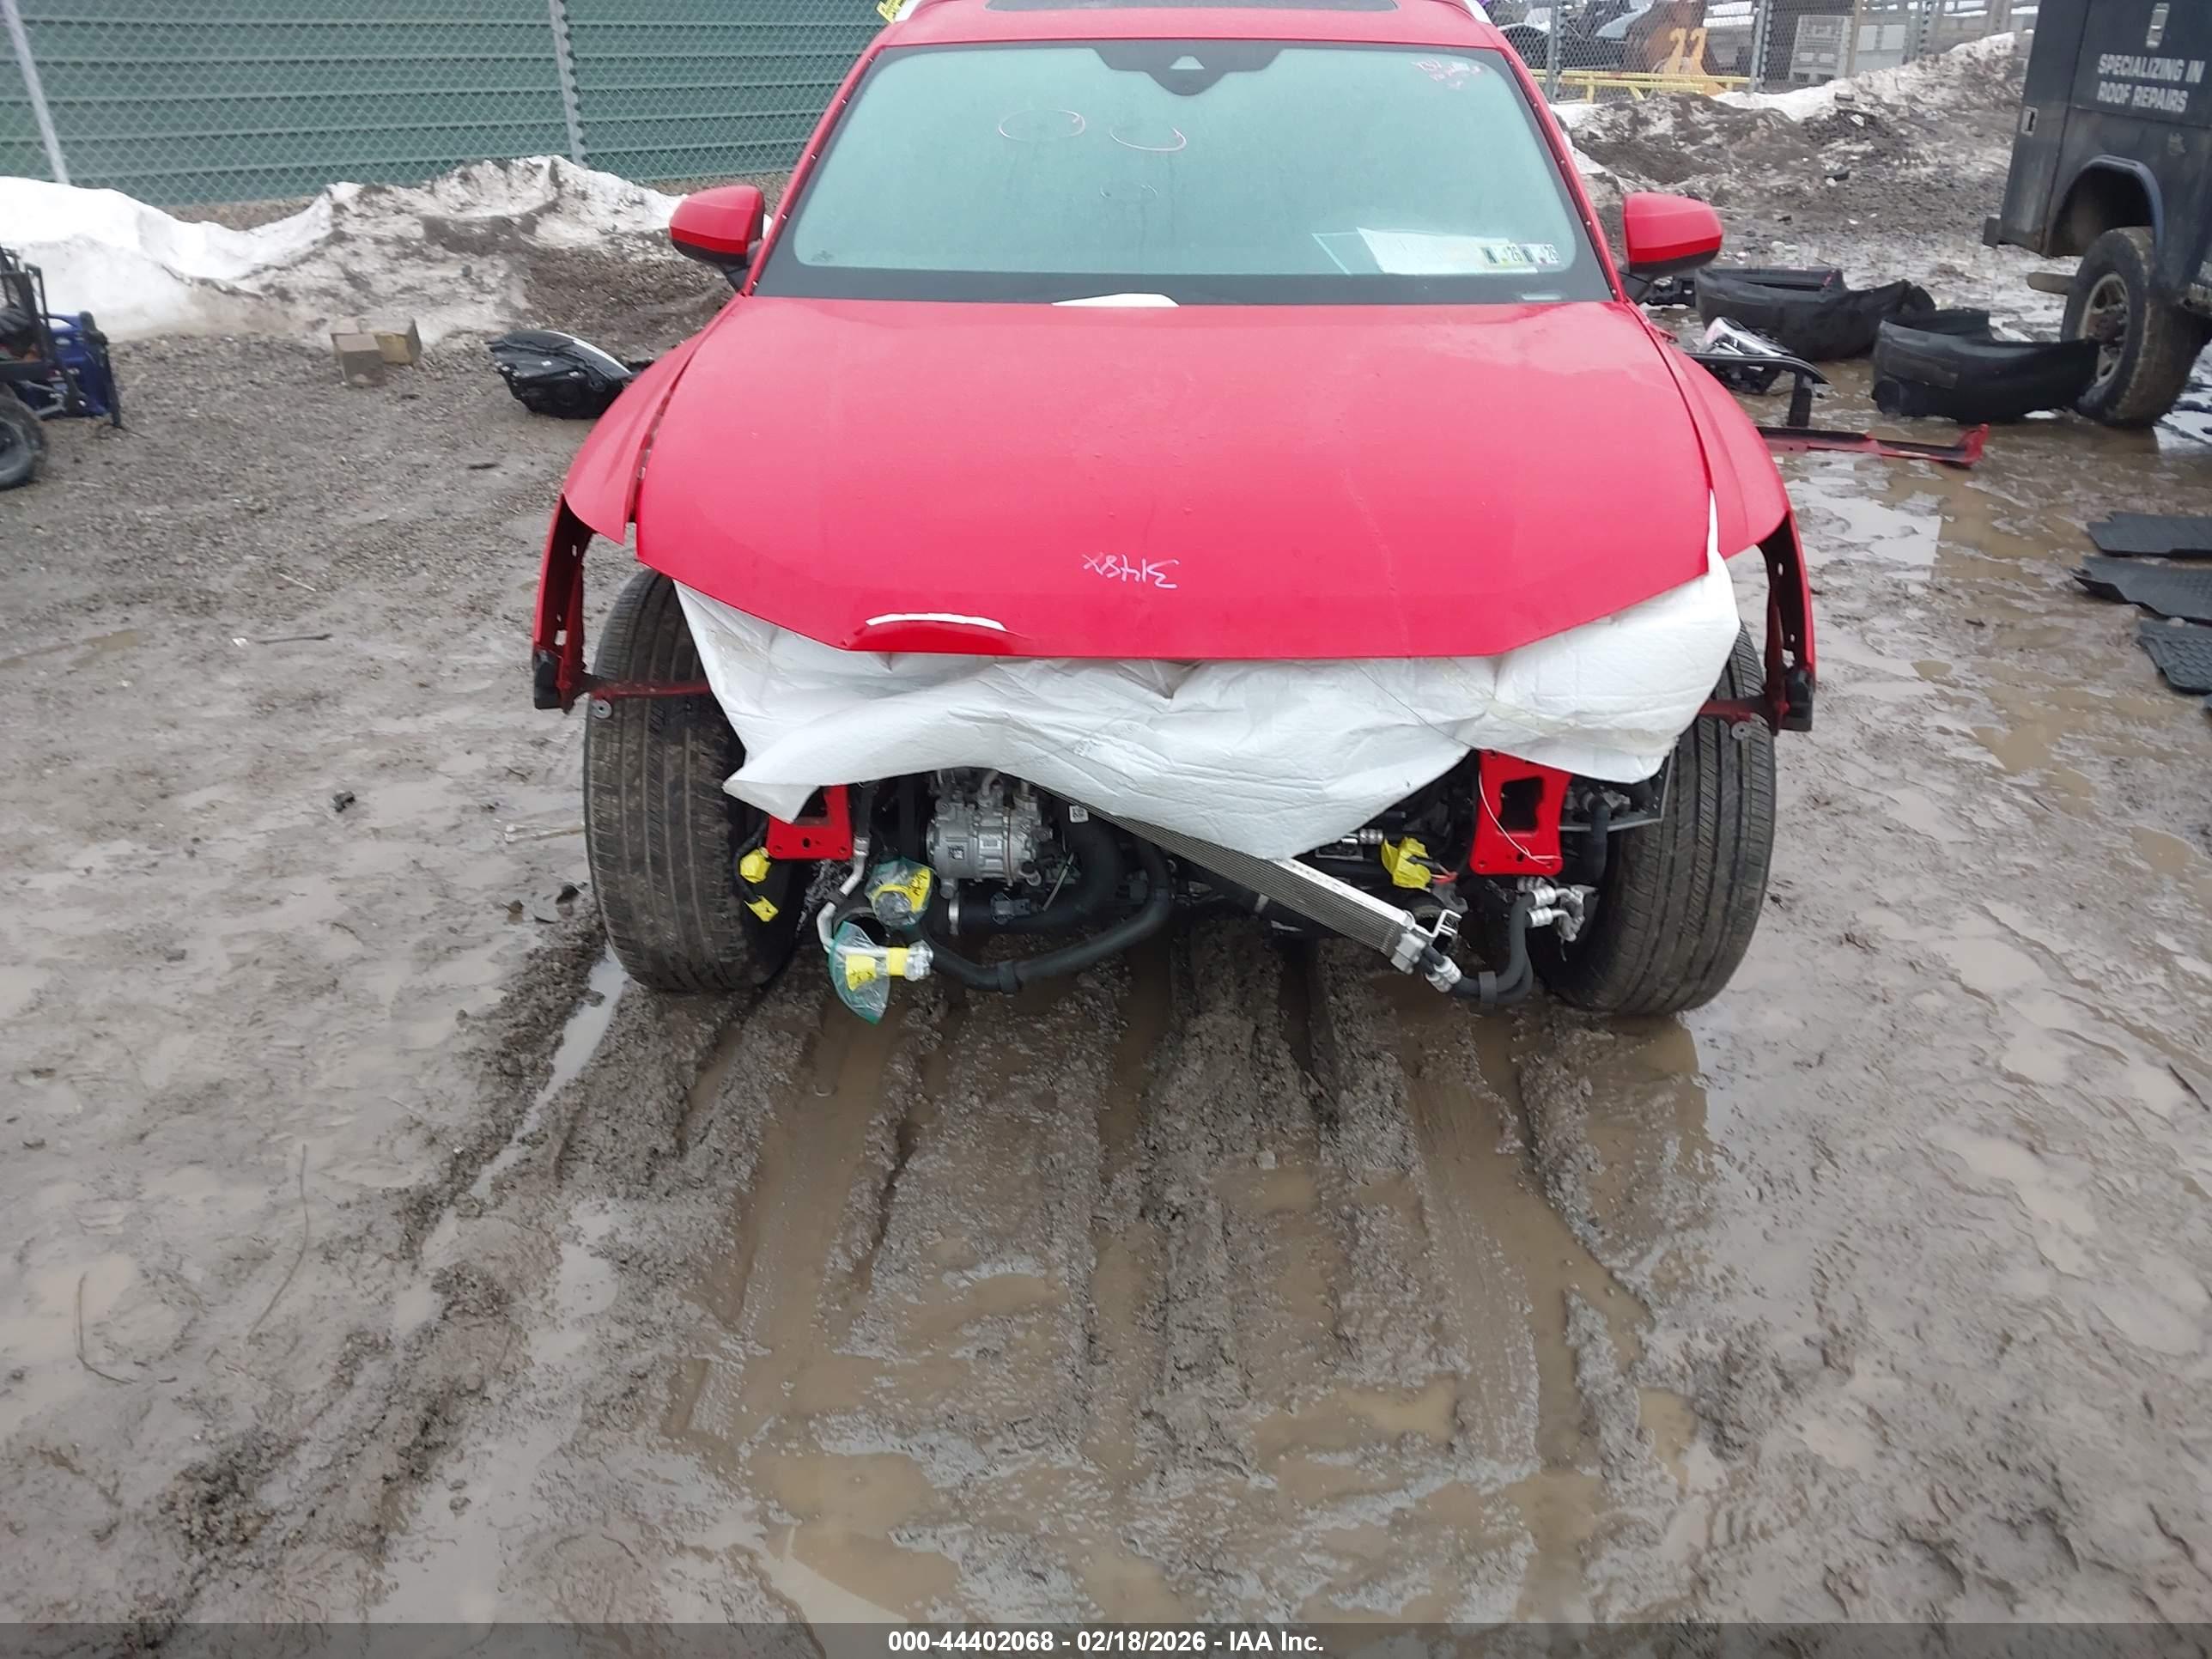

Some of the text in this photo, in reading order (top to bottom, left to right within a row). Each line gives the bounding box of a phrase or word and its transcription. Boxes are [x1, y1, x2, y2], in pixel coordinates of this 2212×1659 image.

[2098, 53, 2206, 83] SPECIALIZING IN
[2097, 81, 2189, 112] ROOF REPAIRS
